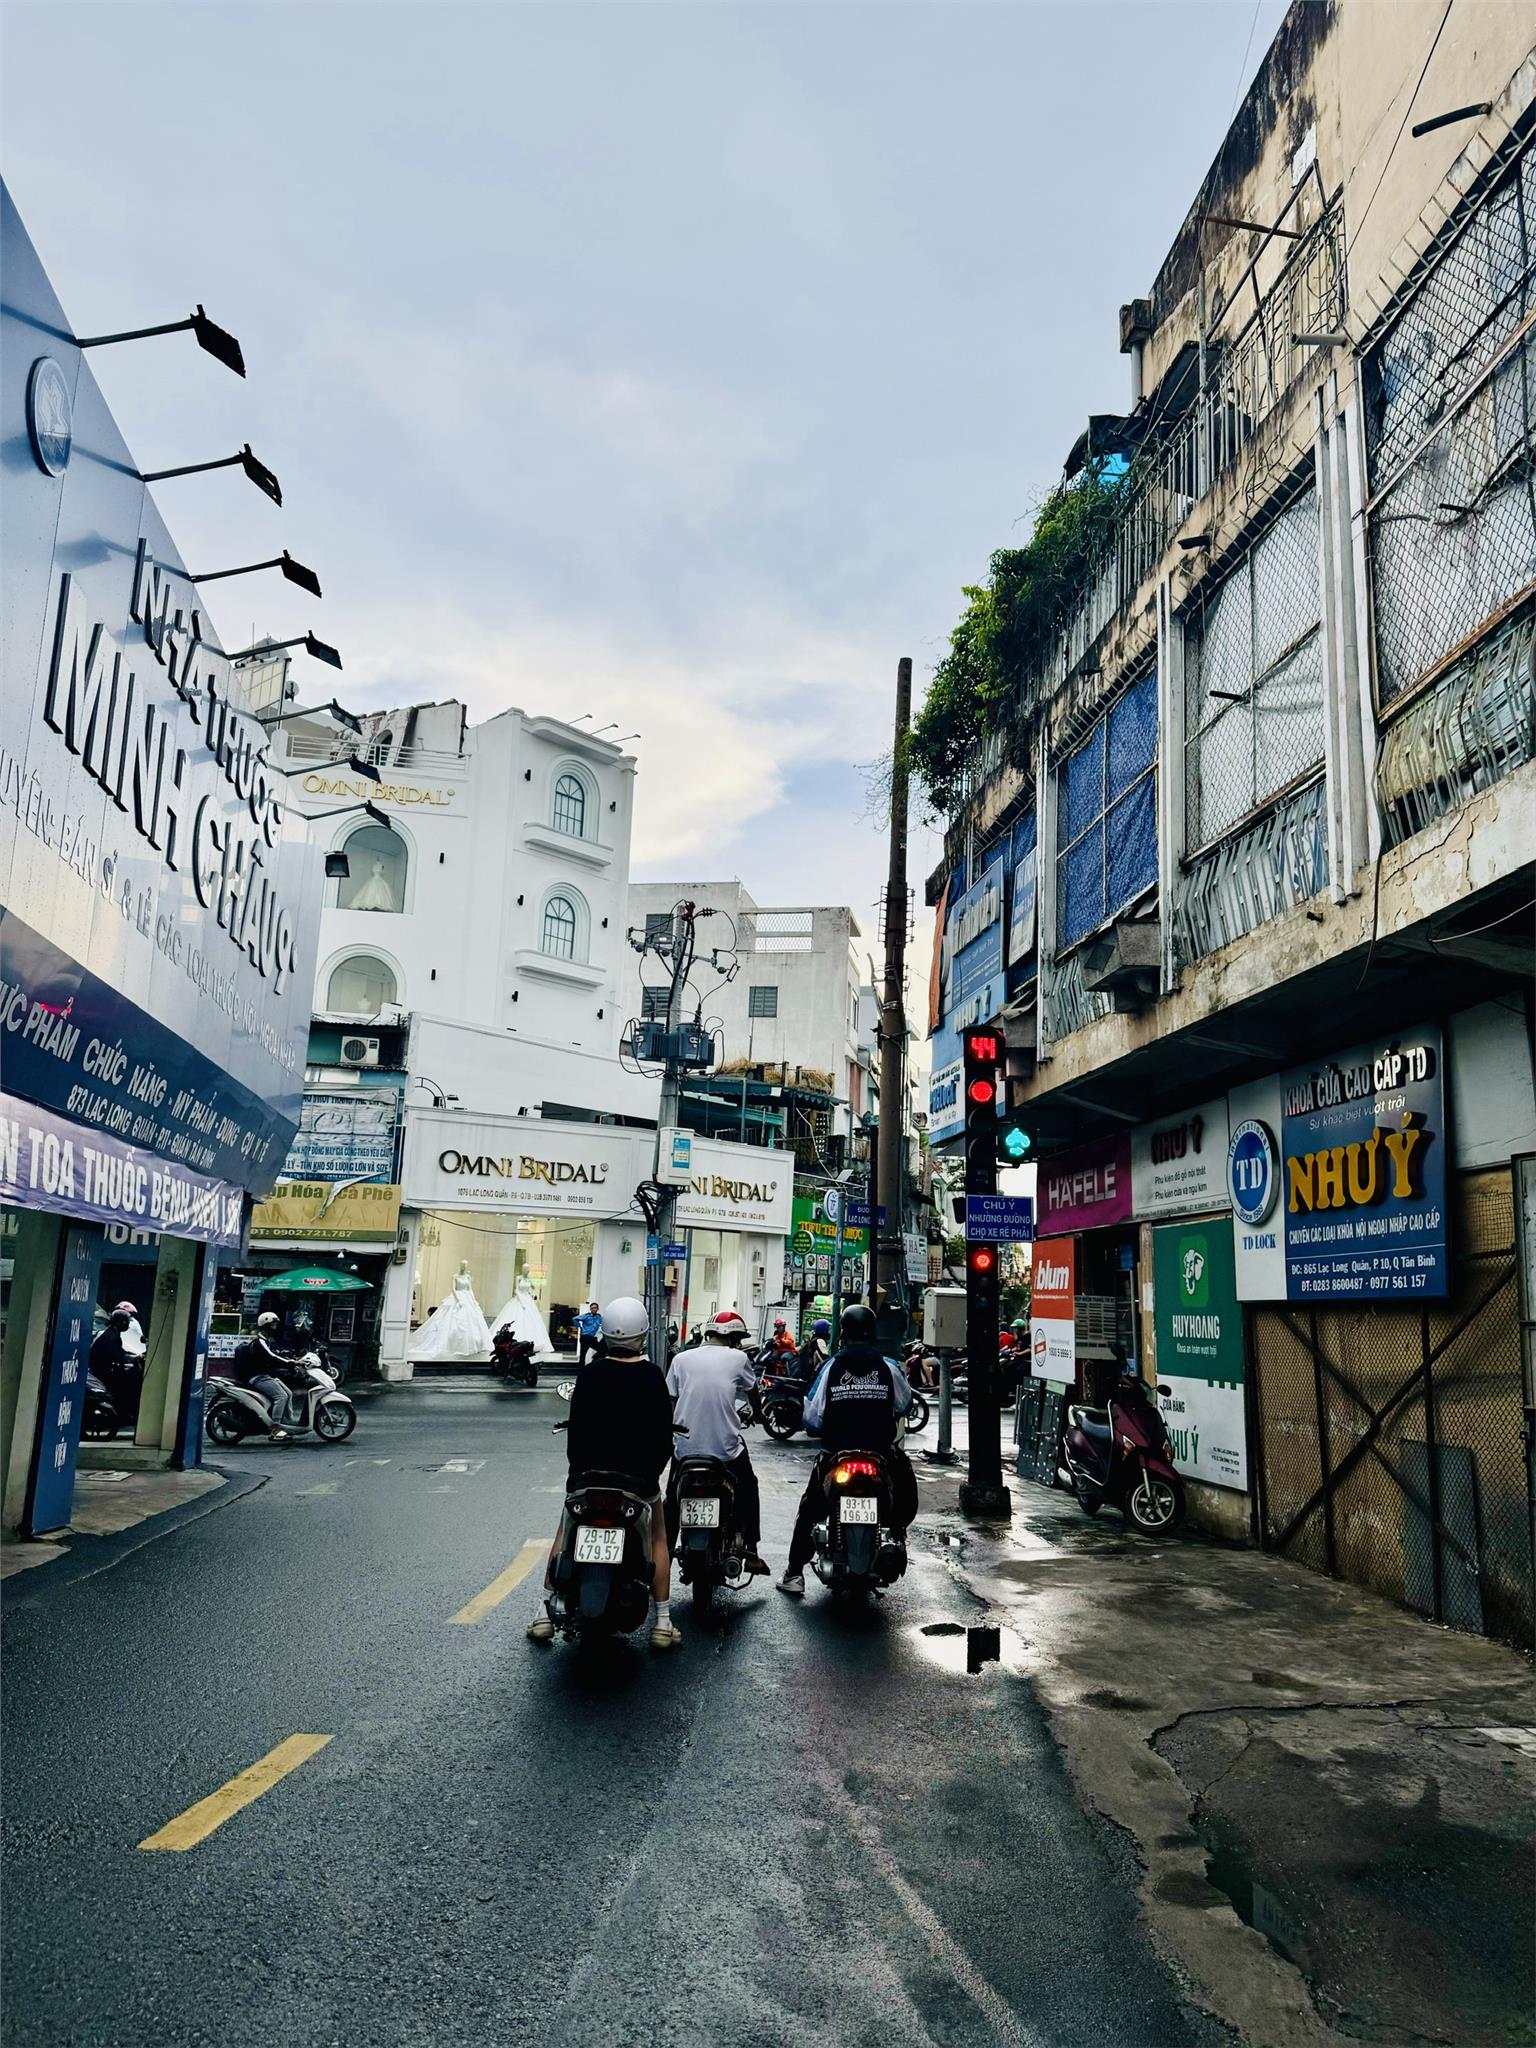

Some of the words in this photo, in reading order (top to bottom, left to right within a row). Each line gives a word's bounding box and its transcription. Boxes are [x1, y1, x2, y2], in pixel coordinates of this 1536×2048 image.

[43, 572, 188, 872] MINH
[303, 774, 367, 798] OMNI
[59, 813, 97, 889] BÁN
[121, 877, 133, 922] &
[156, 911, 183, 967] CÁC
[186, 943, 209, 997] LOẠI
[212, 968, 240, 1022] THUỐC
[22, 996, 81, 1063] PHẨM
[83, 1038, 128, 1086] CHỨC
[127, 1061, 168, 1108] NĂNG
[187, 1091, 219, 1136] PHẨM
[216, 1115, 241, 1149] DỤNG
[241, 1130, 257, 1161] CỤ
[251, 1134, 262, 1161] Y
[1344, 1065, 1371, 1100] CAO
[1406, 1046, 1428, 1082] TD
[66, 1084, 89, 1112] 873
[84, 1092, 106, 1123] LẠC
[104, 1102, 133, 1133] LONG
[132, 1113, 158, 1144] QUÂN
[1387, 1094, 1406, 1112] trội
[438, 1149, 513, 1178] OMNI
[1236, 1156, 1264, 1191] TD
[1286, 1126, 1380, 1214] NHƯ
[1384, 1110, 1420, 1198] Ý
[28, 1127, 75, 1199] TOA
[83, 1145, 148, 1215] THUỐC
[150, 1165, 190, 1231] BỆNH
[291, 1184, 323, 1198] Hóa
[362, 1187, 393, 1201] Phê
[1048, 1163, 1117, 1211] HÄFELE
[988, 1227, 998, 1238] XE
[1310, 1223, 1323, 1243] CÁC
[1322, 1223, 1337, 1244] LOẠI
[1336, 1219, 1354, 1240] KHÓA
[1355, 1217, 1367, 1241] NỘI
[1367, 1217, 1388, 1238] NGOẠI
[1389, 1211, 1409, 1236] NHẬP
[1409, 1213, 1424, 1231] CAO
[1425, 1205, 1441, 1230] CẤP
[1243, 1236, 1255, 1251] TD
[1255, 1233, 1277, 1250] LOCK
[1036, 1259, 1070, 1290] blum
[1303, 1262, 1317, 1275] 865
[1317, 1262, 1330, 1276] Lạc
[1332, 1261, 1349, 1274] Long
[1401, 1255, 1415, 1268] Tân
[1417, 1254, 1436, 1267] Bình
[1312, 1279, 1330, 1291] 0283
[1331, 1278, 1364, 1290] 8600487
[1370, 1276, 1389, 1289] 0977
[1392, 1275, 1408, 1288] 561
[1411, 1274, 1427, 1288] 157
[1172, 1314, 1221, 1340] HUYHOANG
[1190, 1424, 1200, 1465] Ý
[843, 1510, 876, 1522] 196.30
[584, 1529, 617, 1544] 29-D2
[578, 1544, 620, 1561] 479.57
